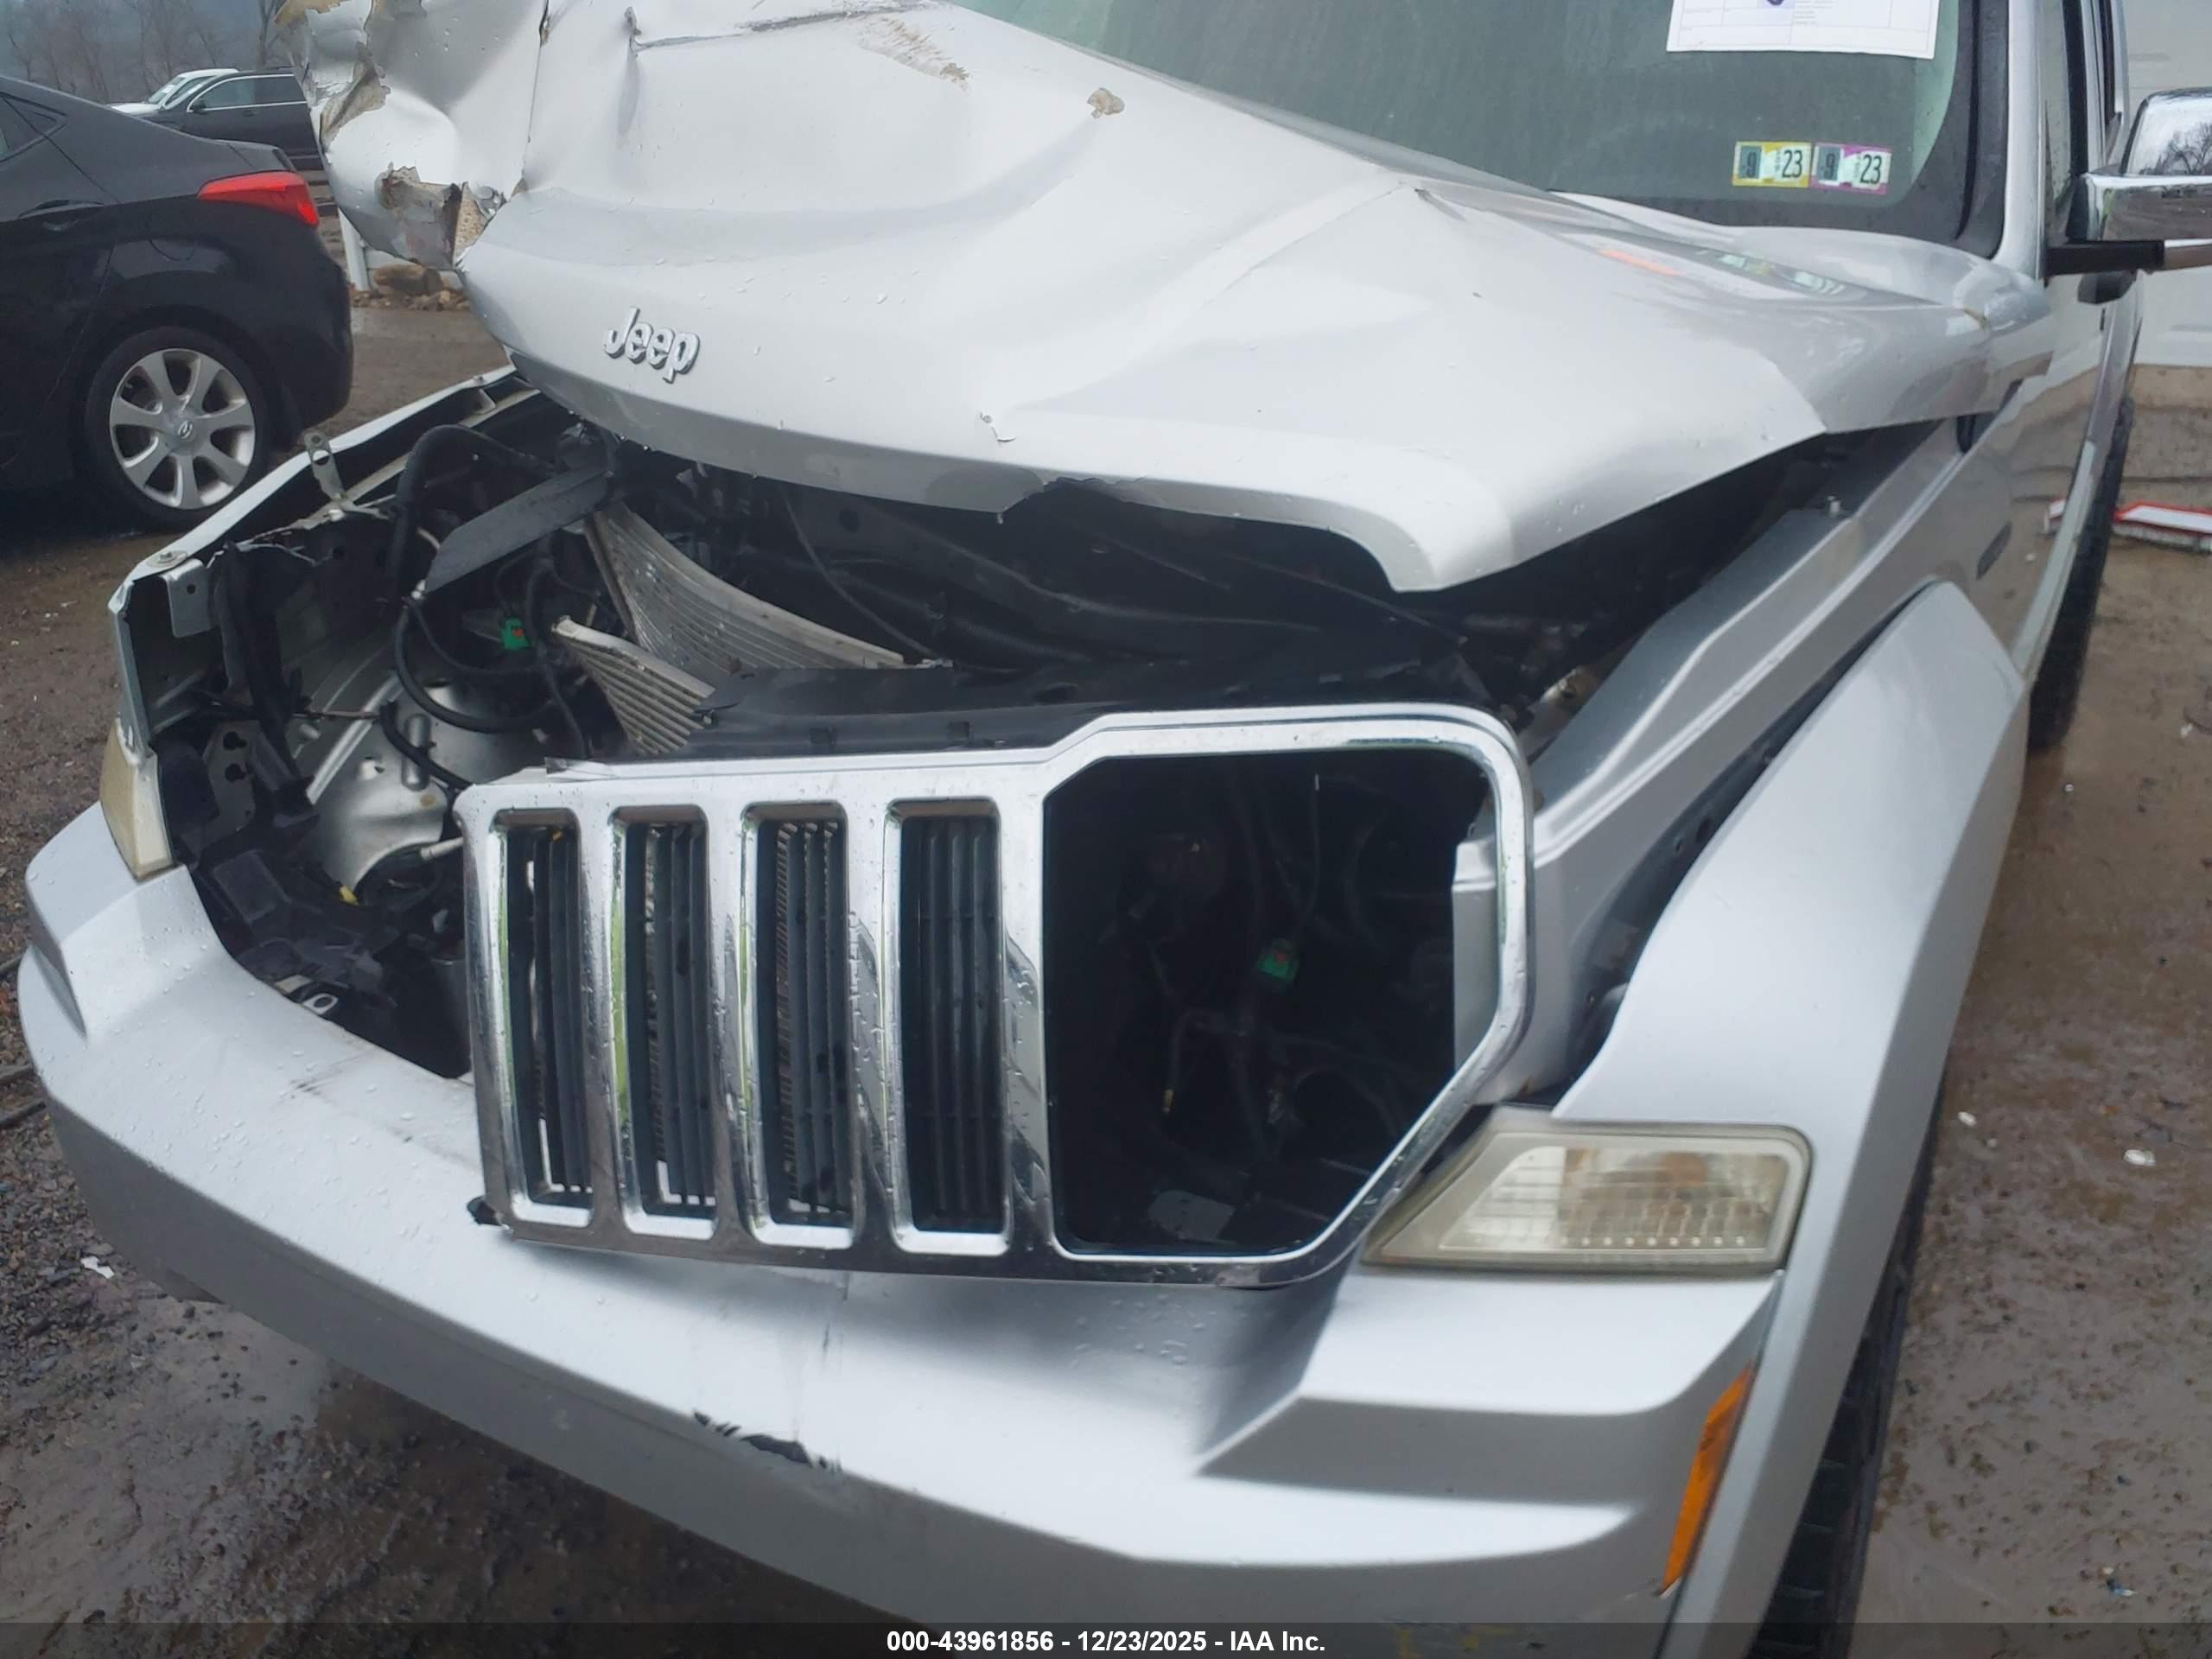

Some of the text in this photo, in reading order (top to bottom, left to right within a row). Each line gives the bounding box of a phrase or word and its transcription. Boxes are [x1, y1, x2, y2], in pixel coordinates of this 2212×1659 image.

[1782, 149, 1802, 178] 23
[1859, 154, 1883, 184] 23
[603, 306, 701, 385] Jeep
